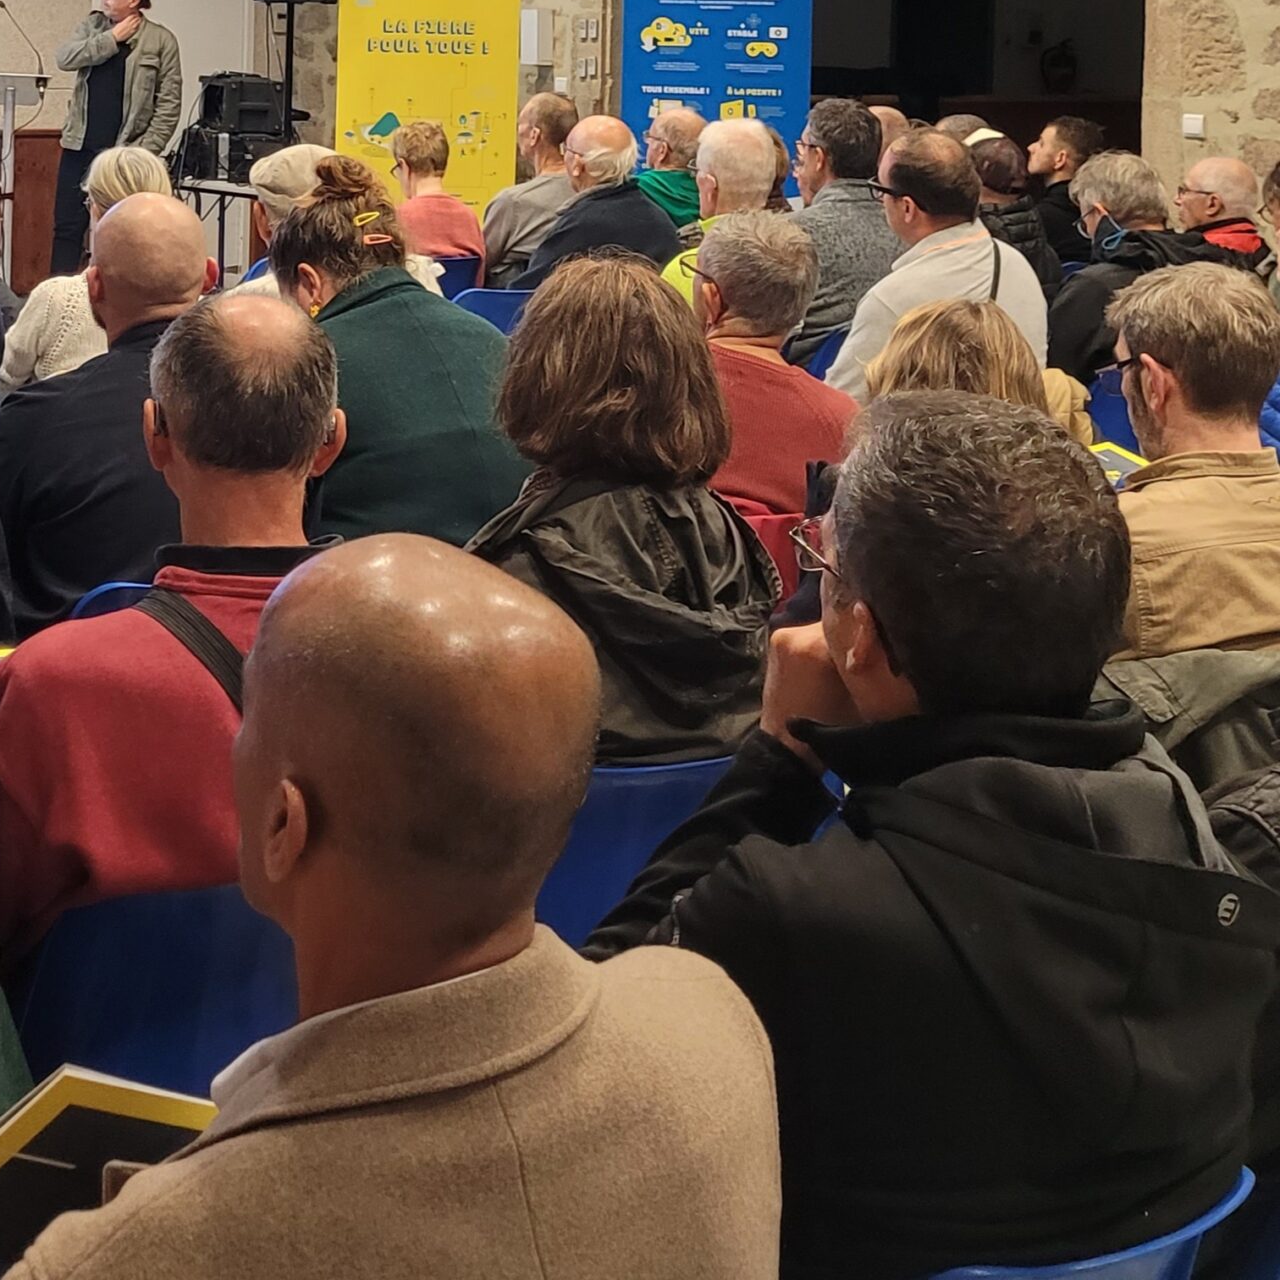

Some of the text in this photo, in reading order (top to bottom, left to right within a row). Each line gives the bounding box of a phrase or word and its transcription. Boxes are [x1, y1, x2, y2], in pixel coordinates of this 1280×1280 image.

[383, 19, 475, 36] LA FIBRE
[367, 39, 420, 54] POUR
[425, 40, 475, 55] TOUS
